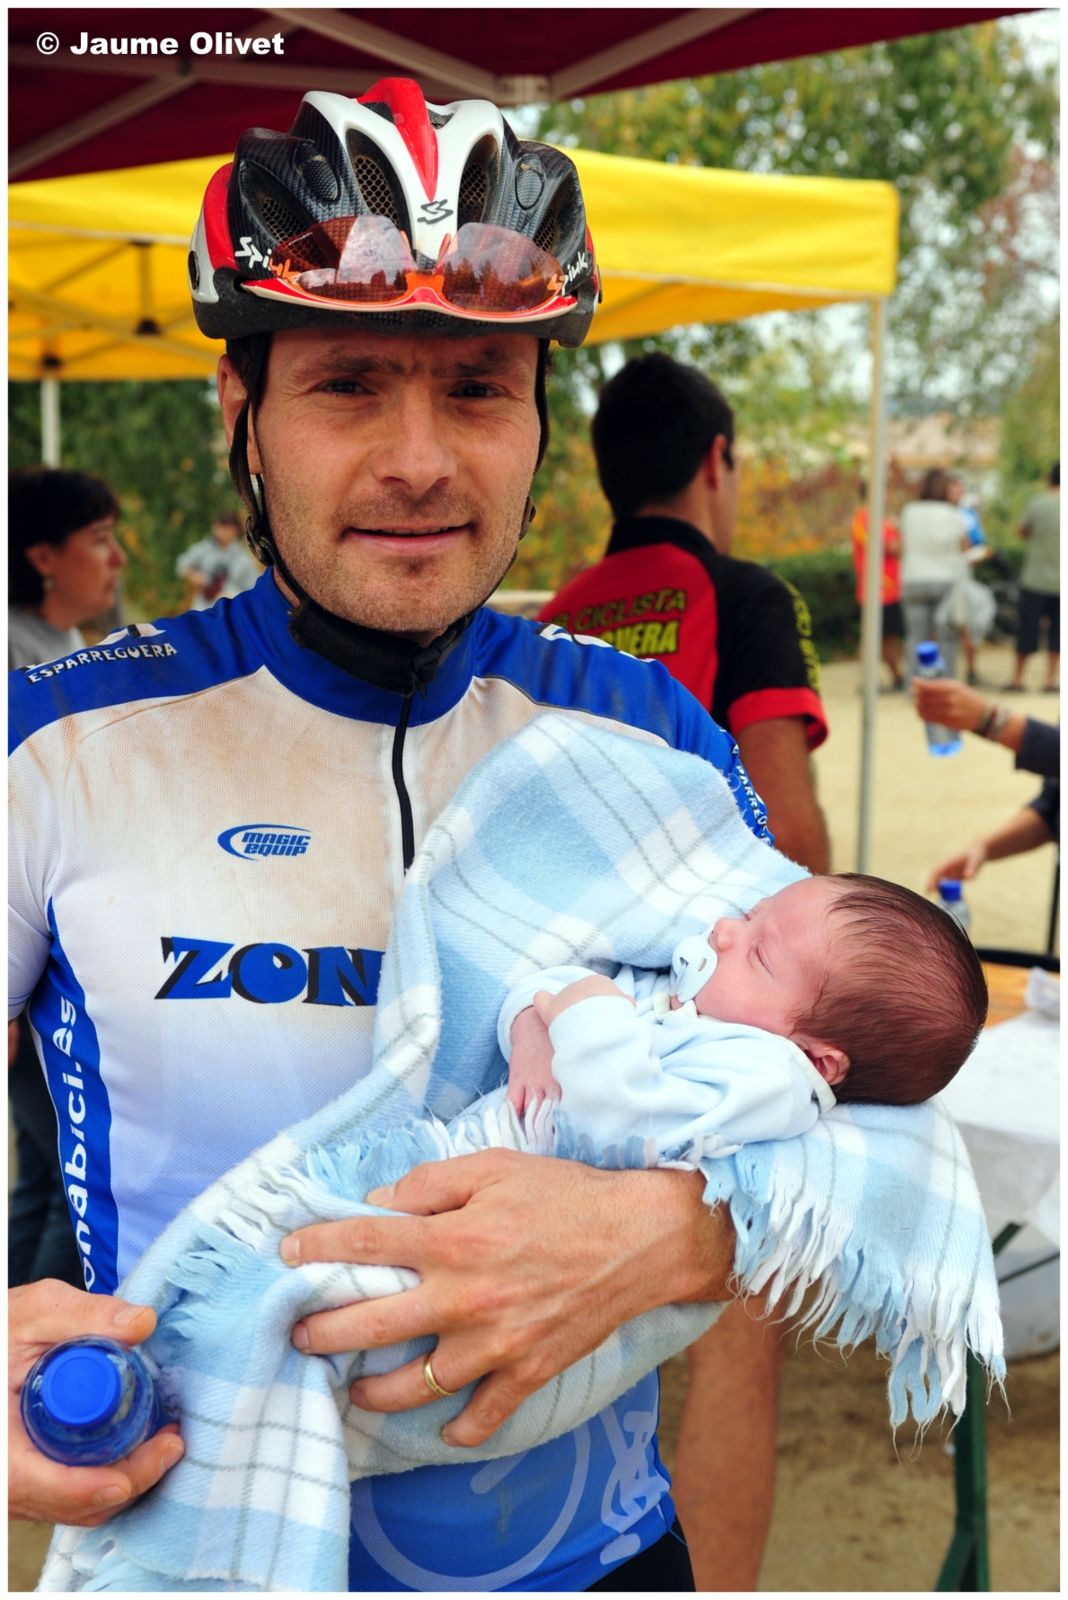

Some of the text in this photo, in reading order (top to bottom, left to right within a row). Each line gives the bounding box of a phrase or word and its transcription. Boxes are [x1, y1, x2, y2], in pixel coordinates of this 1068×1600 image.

[546, 251, 588, 297] Spiuk
[573, 588, 687, 632] CICLISTA
[27, 642, 178, 684] ESPARREGUERA
[241, 832, 311, 846] MAGIC
